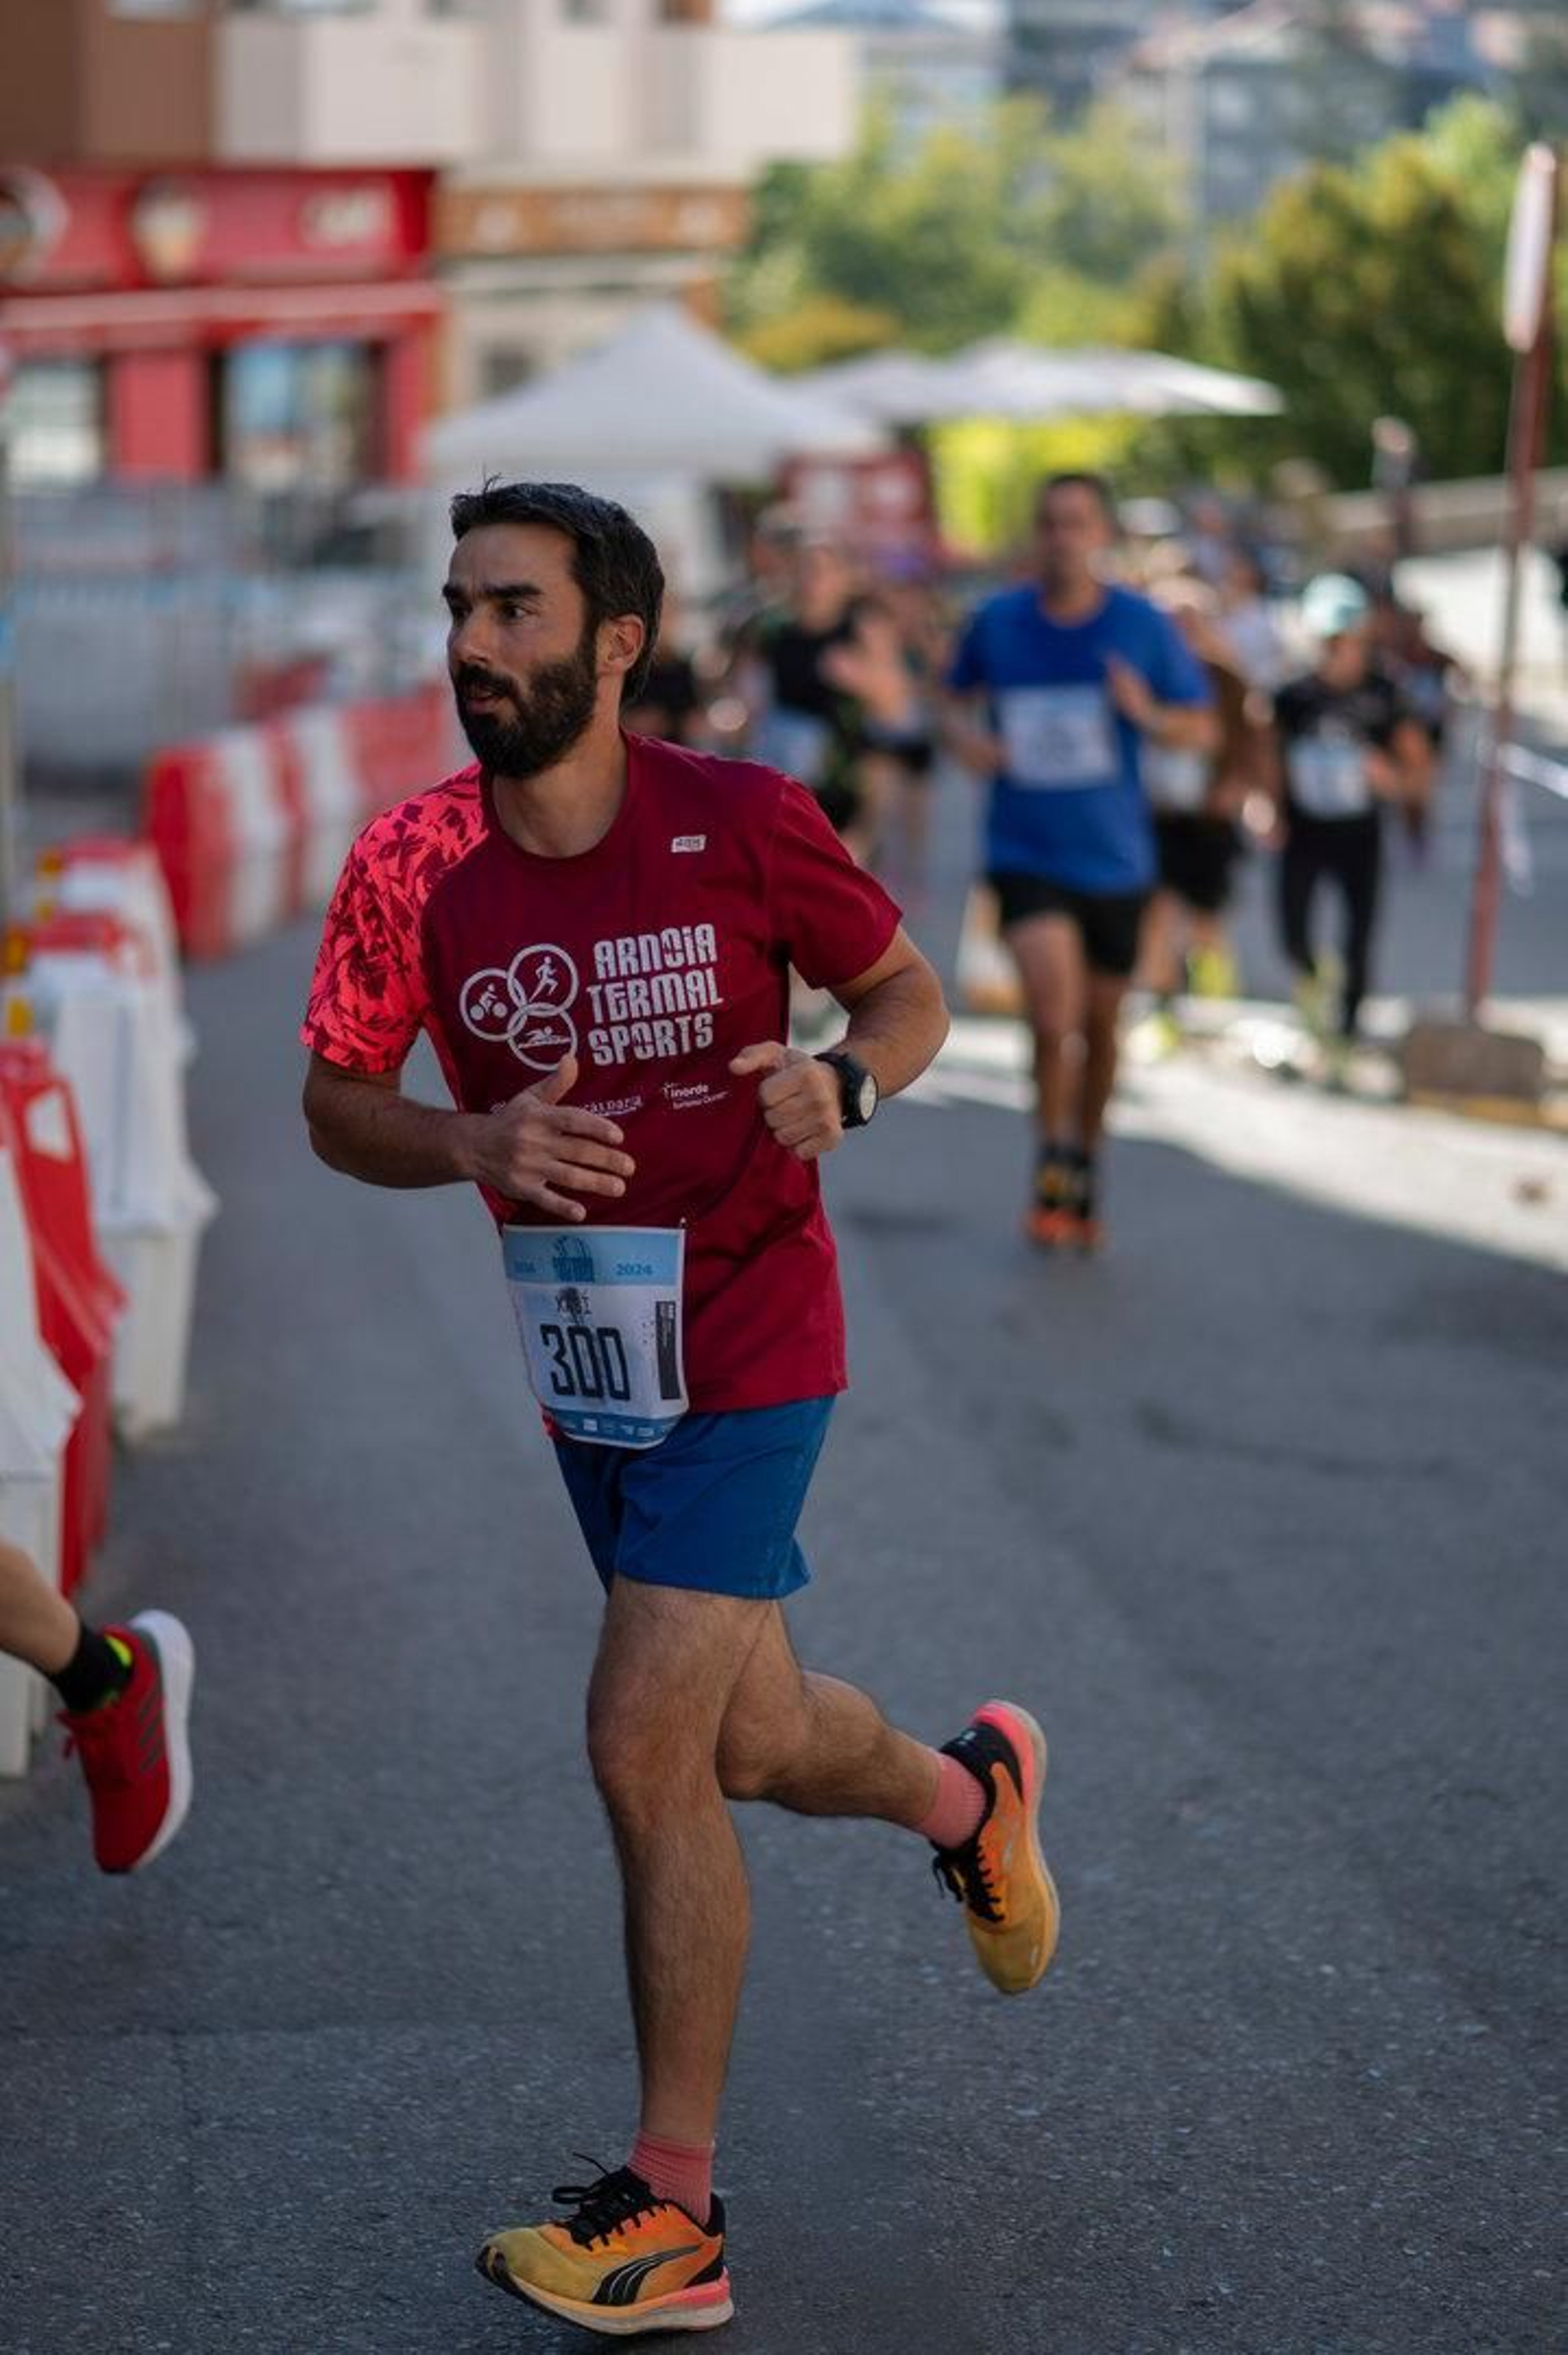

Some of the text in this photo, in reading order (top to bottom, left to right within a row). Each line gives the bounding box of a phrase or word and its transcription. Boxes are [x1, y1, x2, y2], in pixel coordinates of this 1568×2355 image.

[586, 967, 724, 1024] TERMAL
[588, 1012, 714, 1066] SPORTS
[616, 1262, 653, 1276] 2024
[540, 1324, 630, 1400] 300
